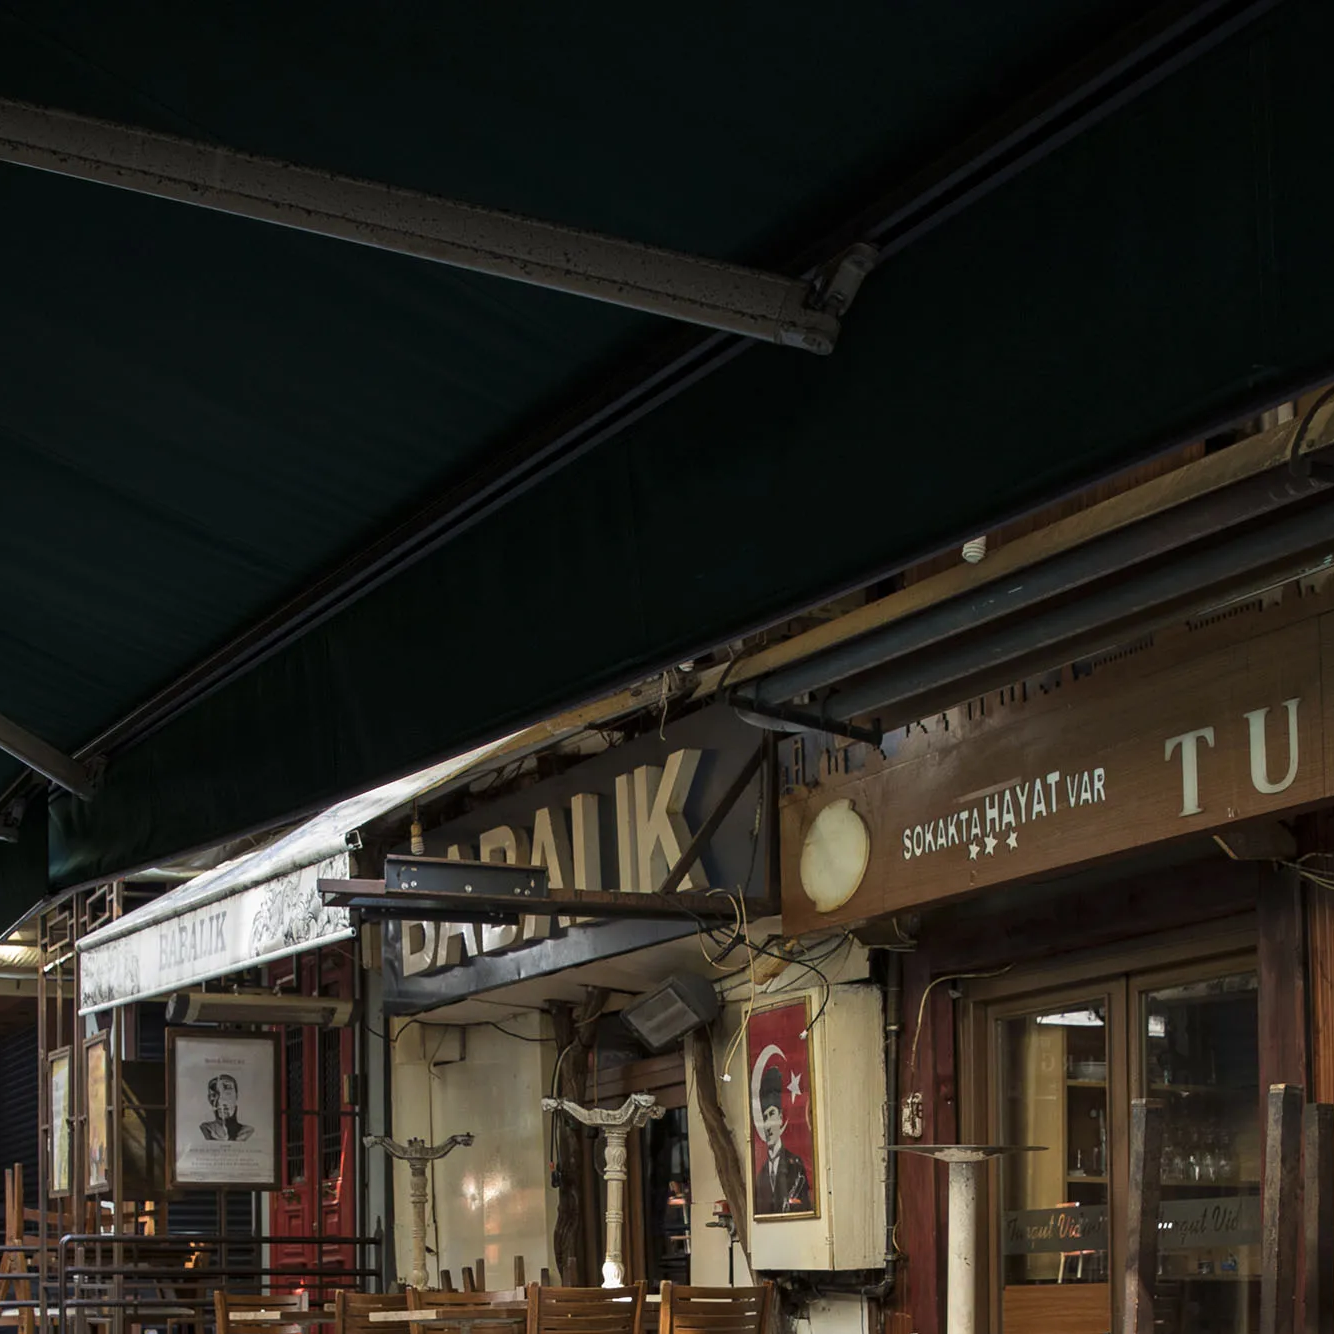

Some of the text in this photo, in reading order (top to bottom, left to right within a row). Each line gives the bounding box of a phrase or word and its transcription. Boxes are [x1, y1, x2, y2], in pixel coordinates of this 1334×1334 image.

[902, 767, 1106, 860] SOKAKTA HAYAT VAR
[159, 911, 227, 971] BABALIK
